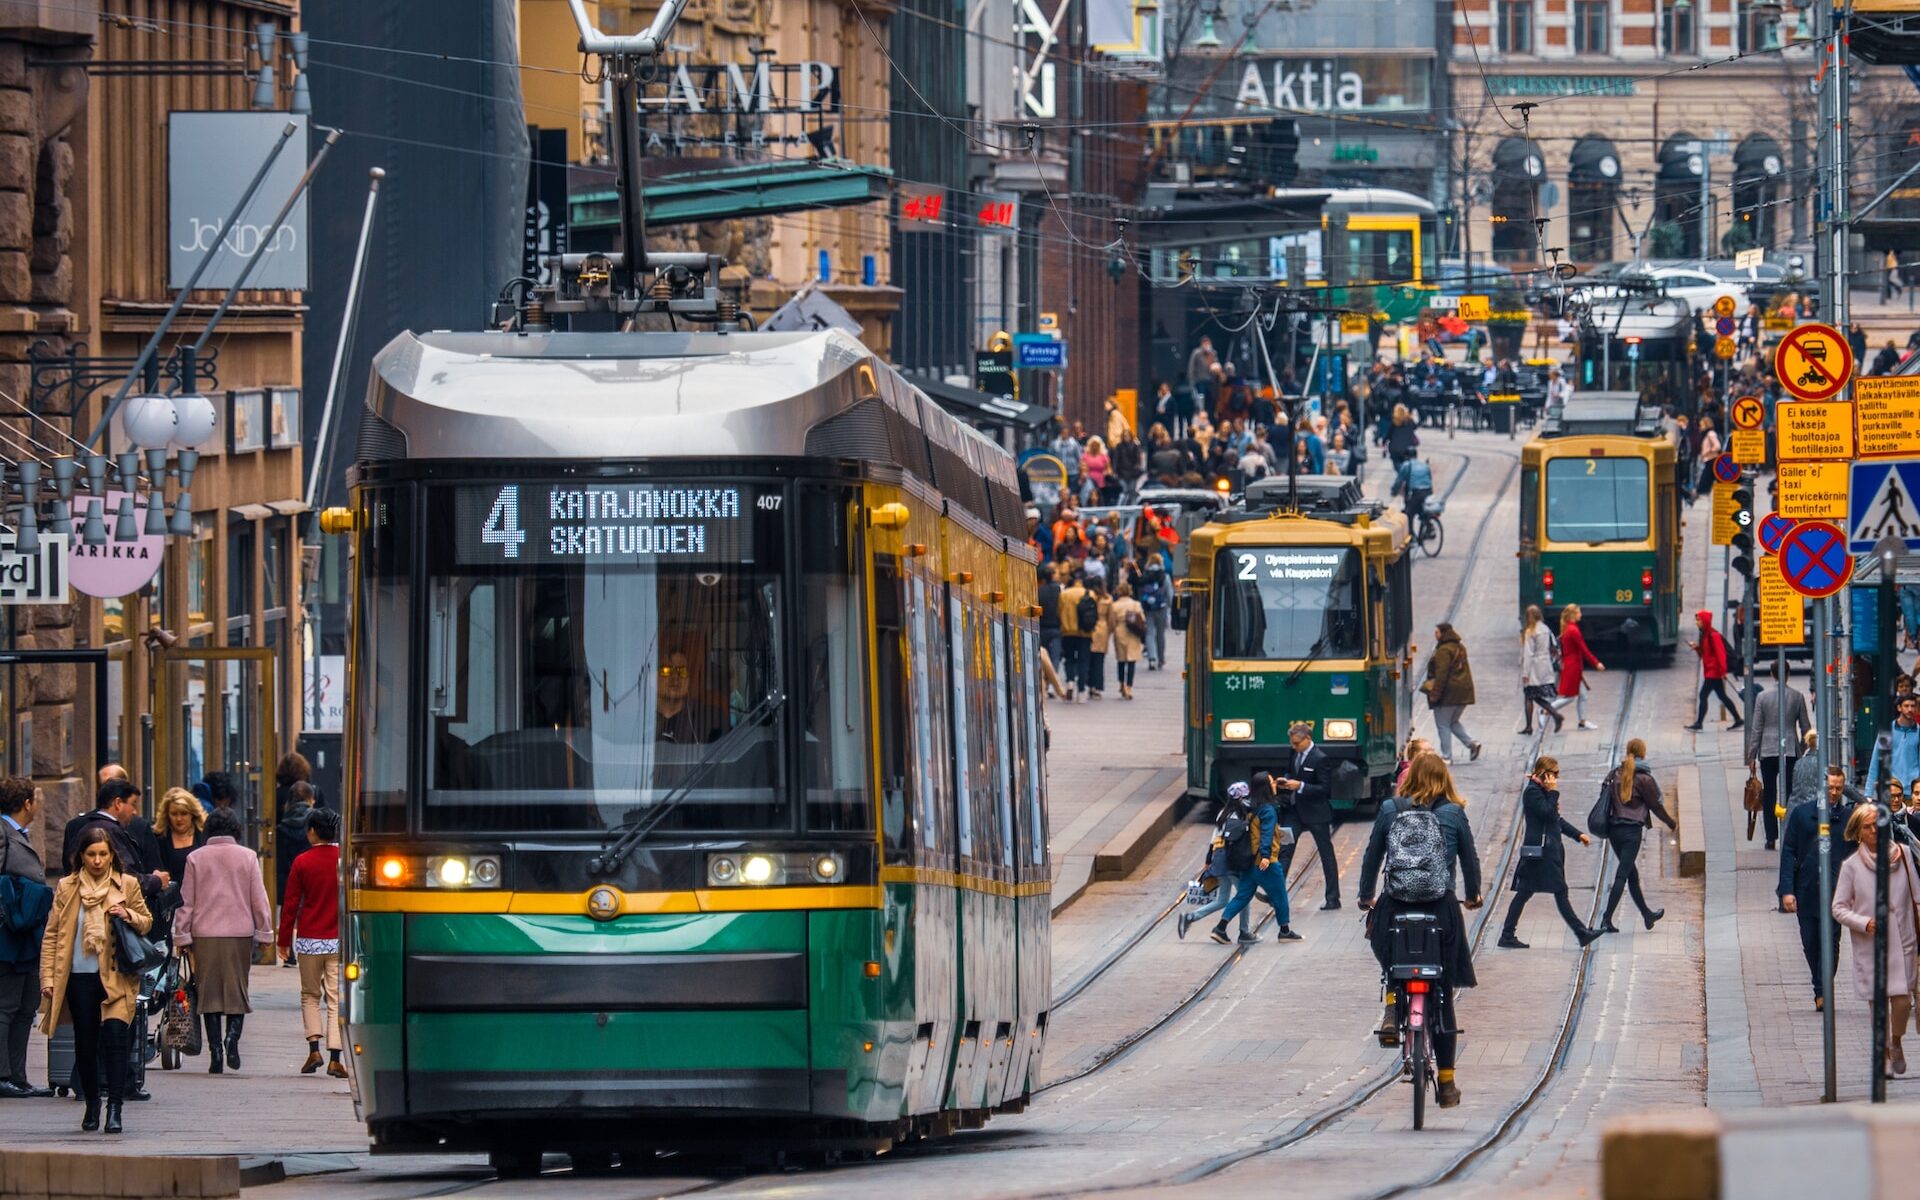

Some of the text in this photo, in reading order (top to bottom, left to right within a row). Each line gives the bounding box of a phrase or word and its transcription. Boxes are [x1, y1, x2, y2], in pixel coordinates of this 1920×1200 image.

[1236, 60, 1363, 111] Aktia
[180, 218, 296, 257] Jokinen
[556, 223, 566, 253] OTEL
[1787, 408, 1828, 419] Ei koske
[1859, 402, 1888, 411] sallittu
[1862, 421, 1903, 432] purkaville
[1585, 459, 1597, 475] 2
[1780, 467, 1821, 480] Gäller ej
[550, 490, 740, 518] KATAJANOKKA
[757, 495, 782, 510] 407
[1781, 491, 1848, 502] -servicekörnin
[482, 486, 526, 558] 4
[1738, 510, 1751, 525] S
[550, 526, 706, 553] SKATUDDEN
[68, 544, 149, 559] ARIKKA
[1238, 553, 1257, 580] 2
[1270, 568, 1333, 580] via Kauppatori
[1615, 589, 1633, 602] 89
